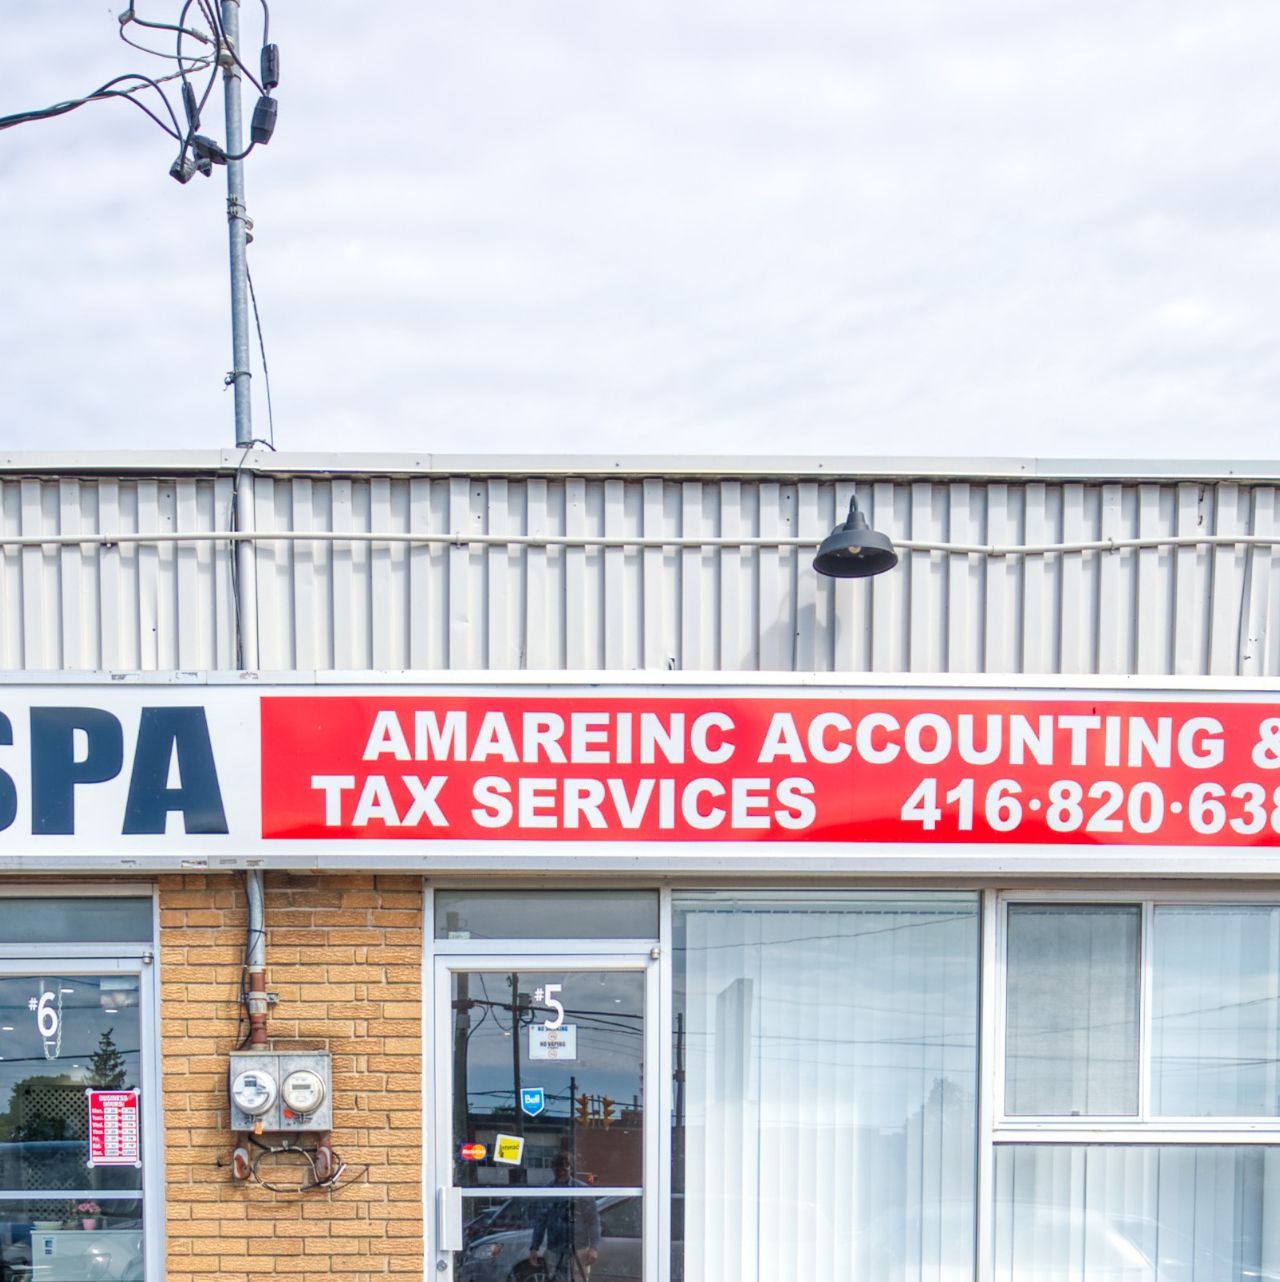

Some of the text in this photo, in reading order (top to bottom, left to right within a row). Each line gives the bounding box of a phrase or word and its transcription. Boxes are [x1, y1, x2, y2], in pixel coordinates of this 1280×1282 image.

[362, 710, 736, 764] AMAREINC
[758, 712, 1225, 769] ACCOUNTING
[311, 775, 449, 827] TAX
[472, 777, 817, 830] SERVICES
